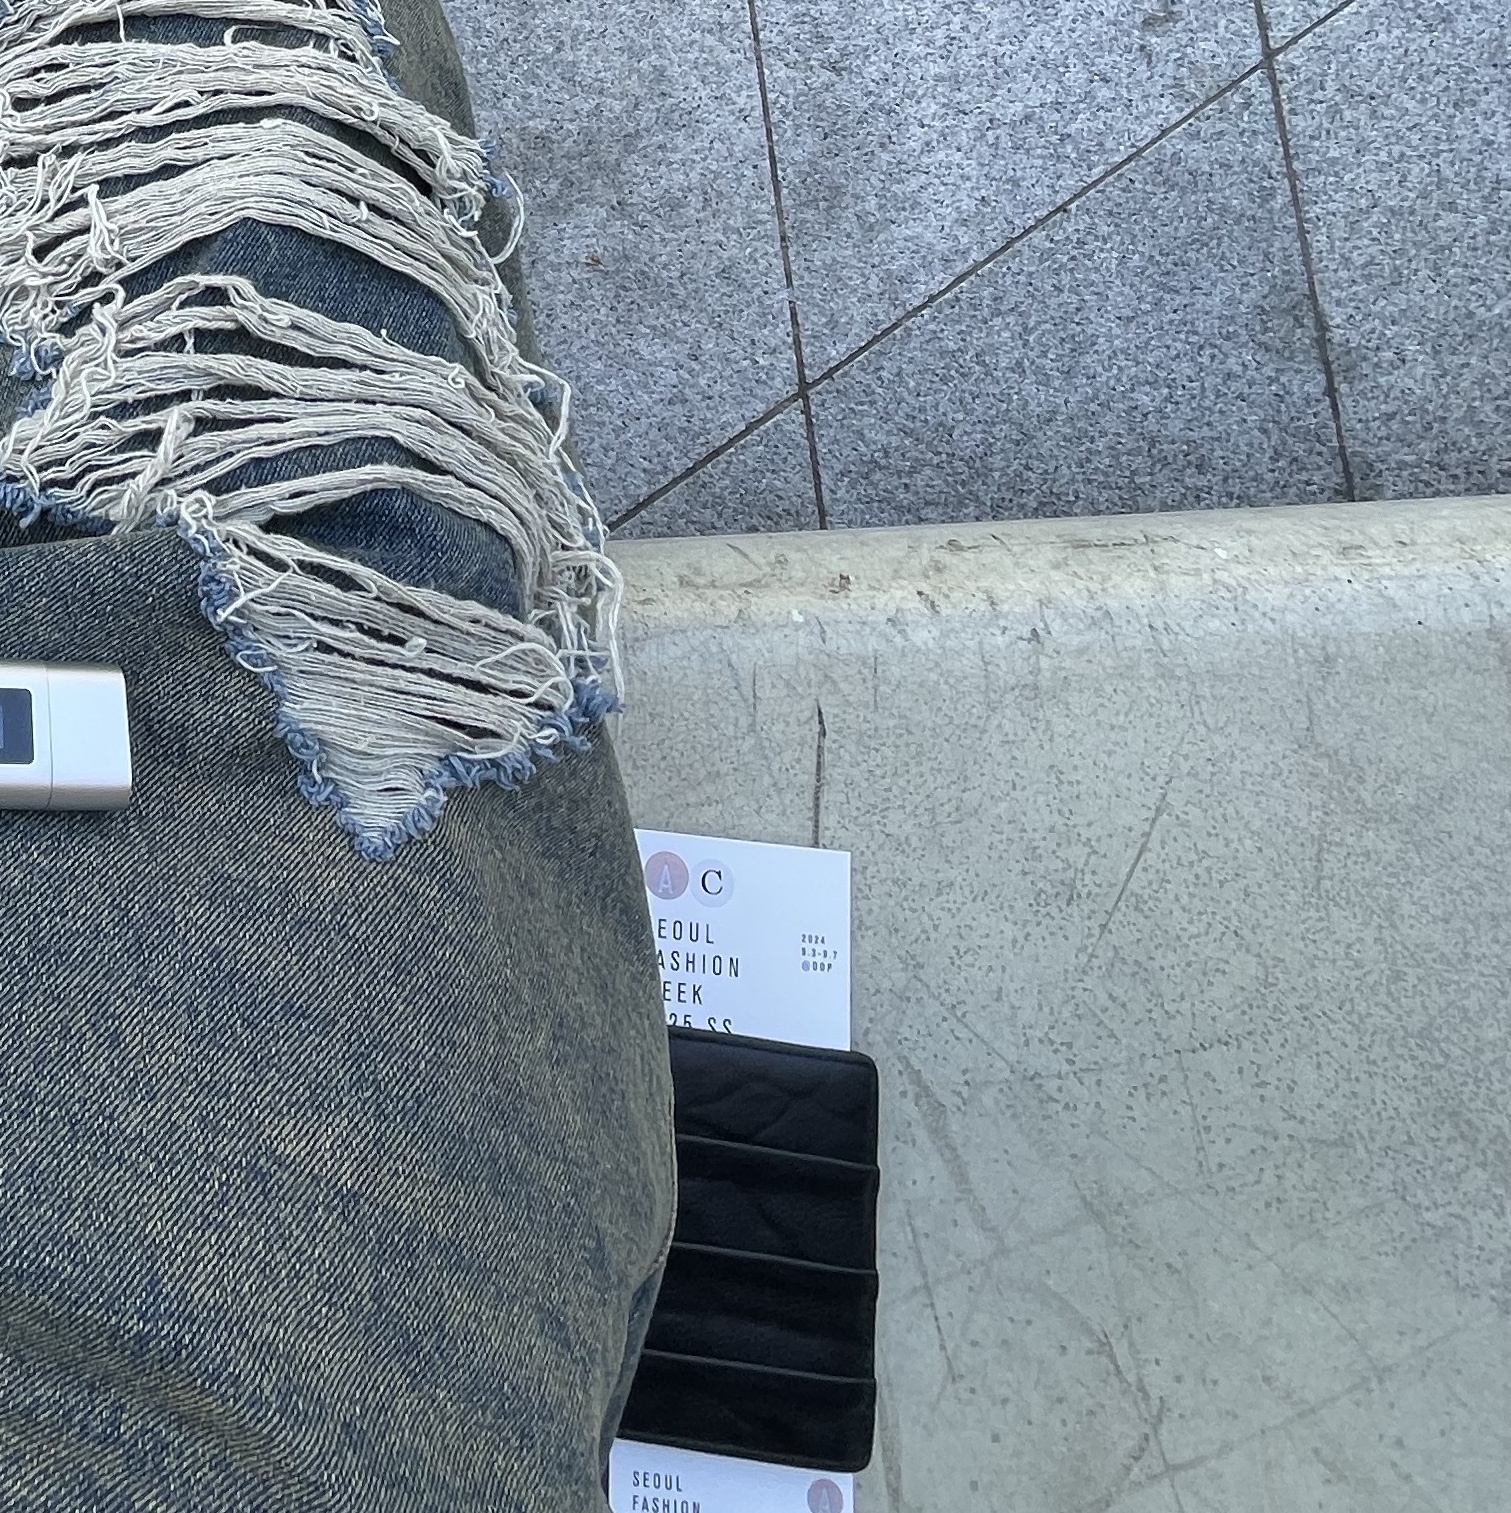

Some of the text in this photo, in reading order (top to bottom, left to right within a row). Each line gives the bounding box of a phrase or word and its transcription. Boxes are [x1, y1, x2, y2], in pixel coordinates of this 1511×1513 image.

[657, 864, 723, 895] A C
[657, 919, 714, 944] EOUL
[801, 934, 826, 945] 2024
[656, 949, 740, 978] ASHION
[662, 981, 703, 1005] EEK
[669, 1013, 692, 1028] 25
[632, 1471, 683, 1492] SEOUL
[632, 1495, 701, 1513] FASHION
